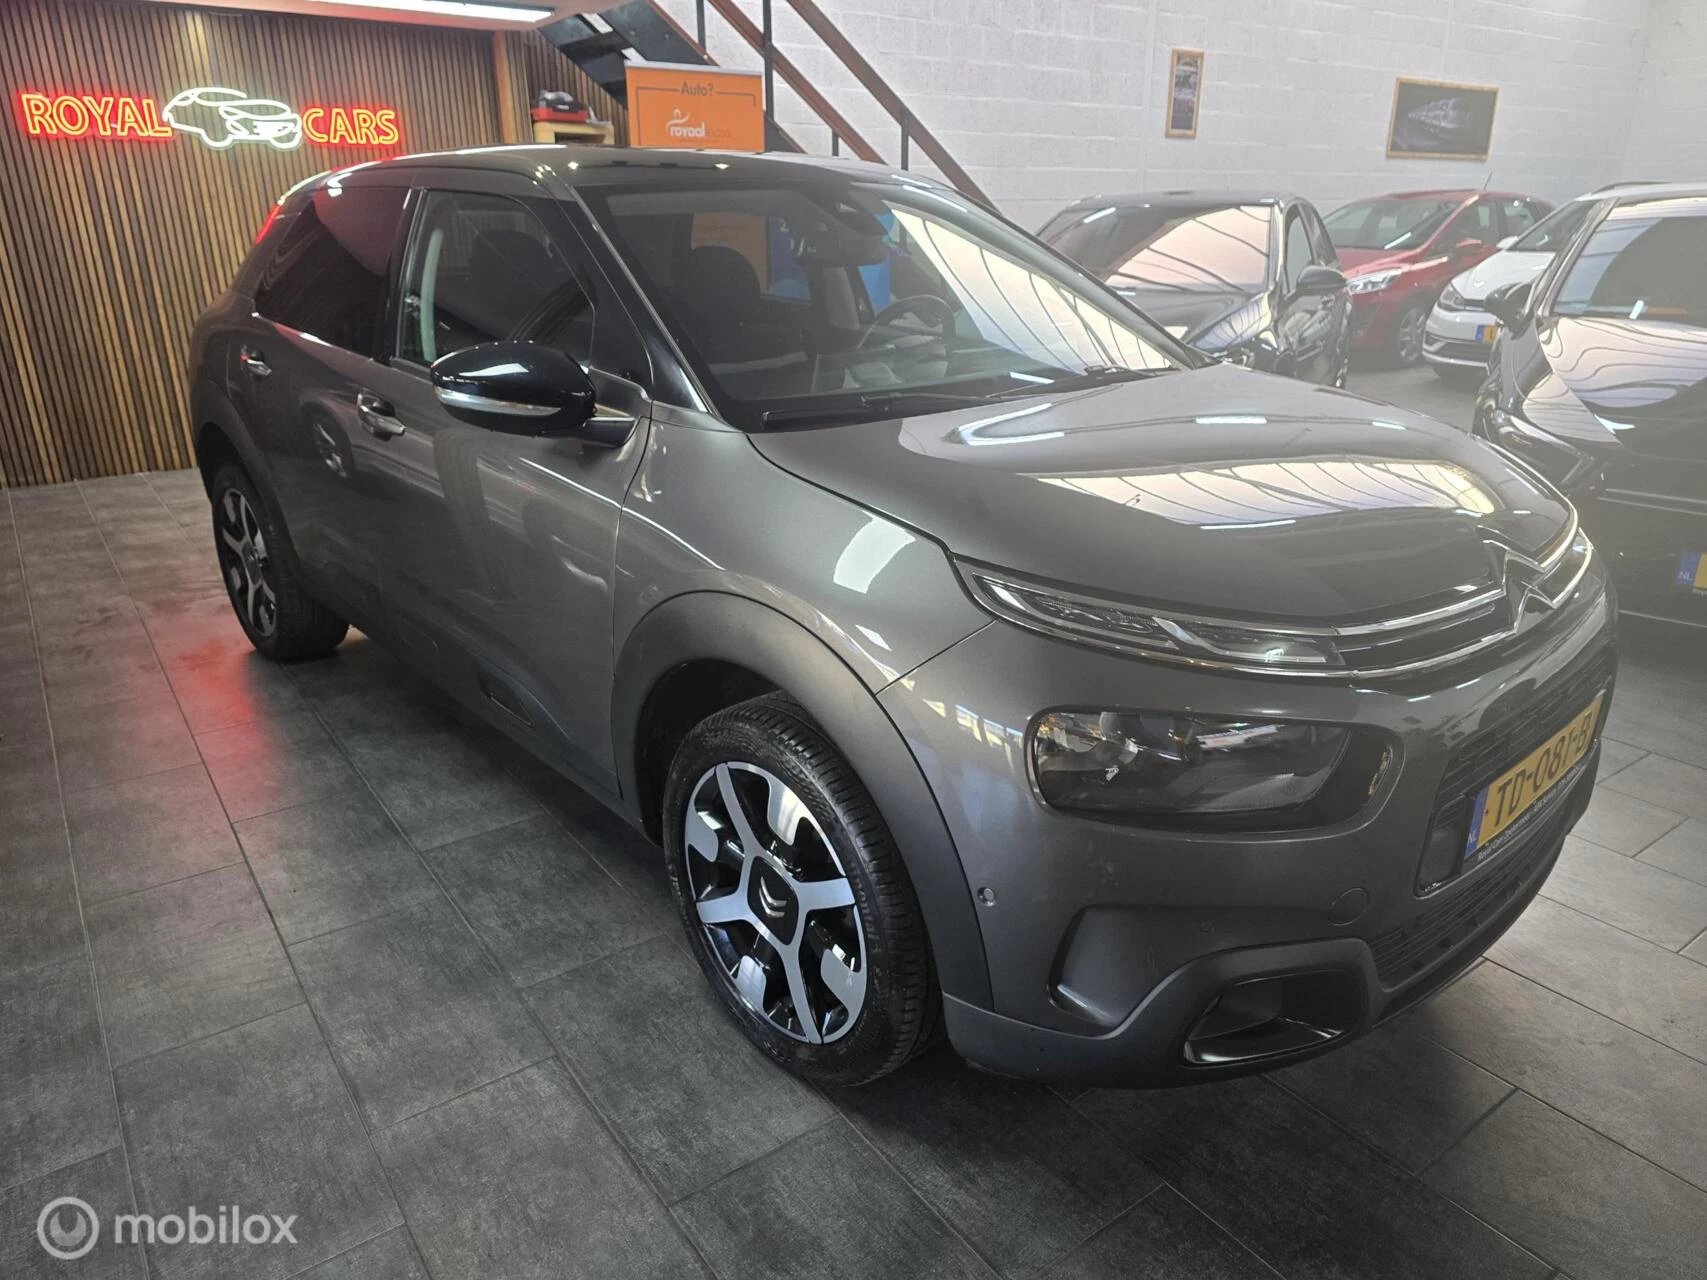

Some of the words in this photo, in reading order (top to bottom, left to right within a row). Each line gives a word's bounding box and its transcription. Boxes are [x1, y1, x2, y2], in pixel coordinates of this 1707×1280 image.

[680, 82, 714, 97] Auto?
[21, 92, 172, 137] ROYAL
[303, 107, 400, 146] CARS
[1679, 571, 1693, 584] NL
